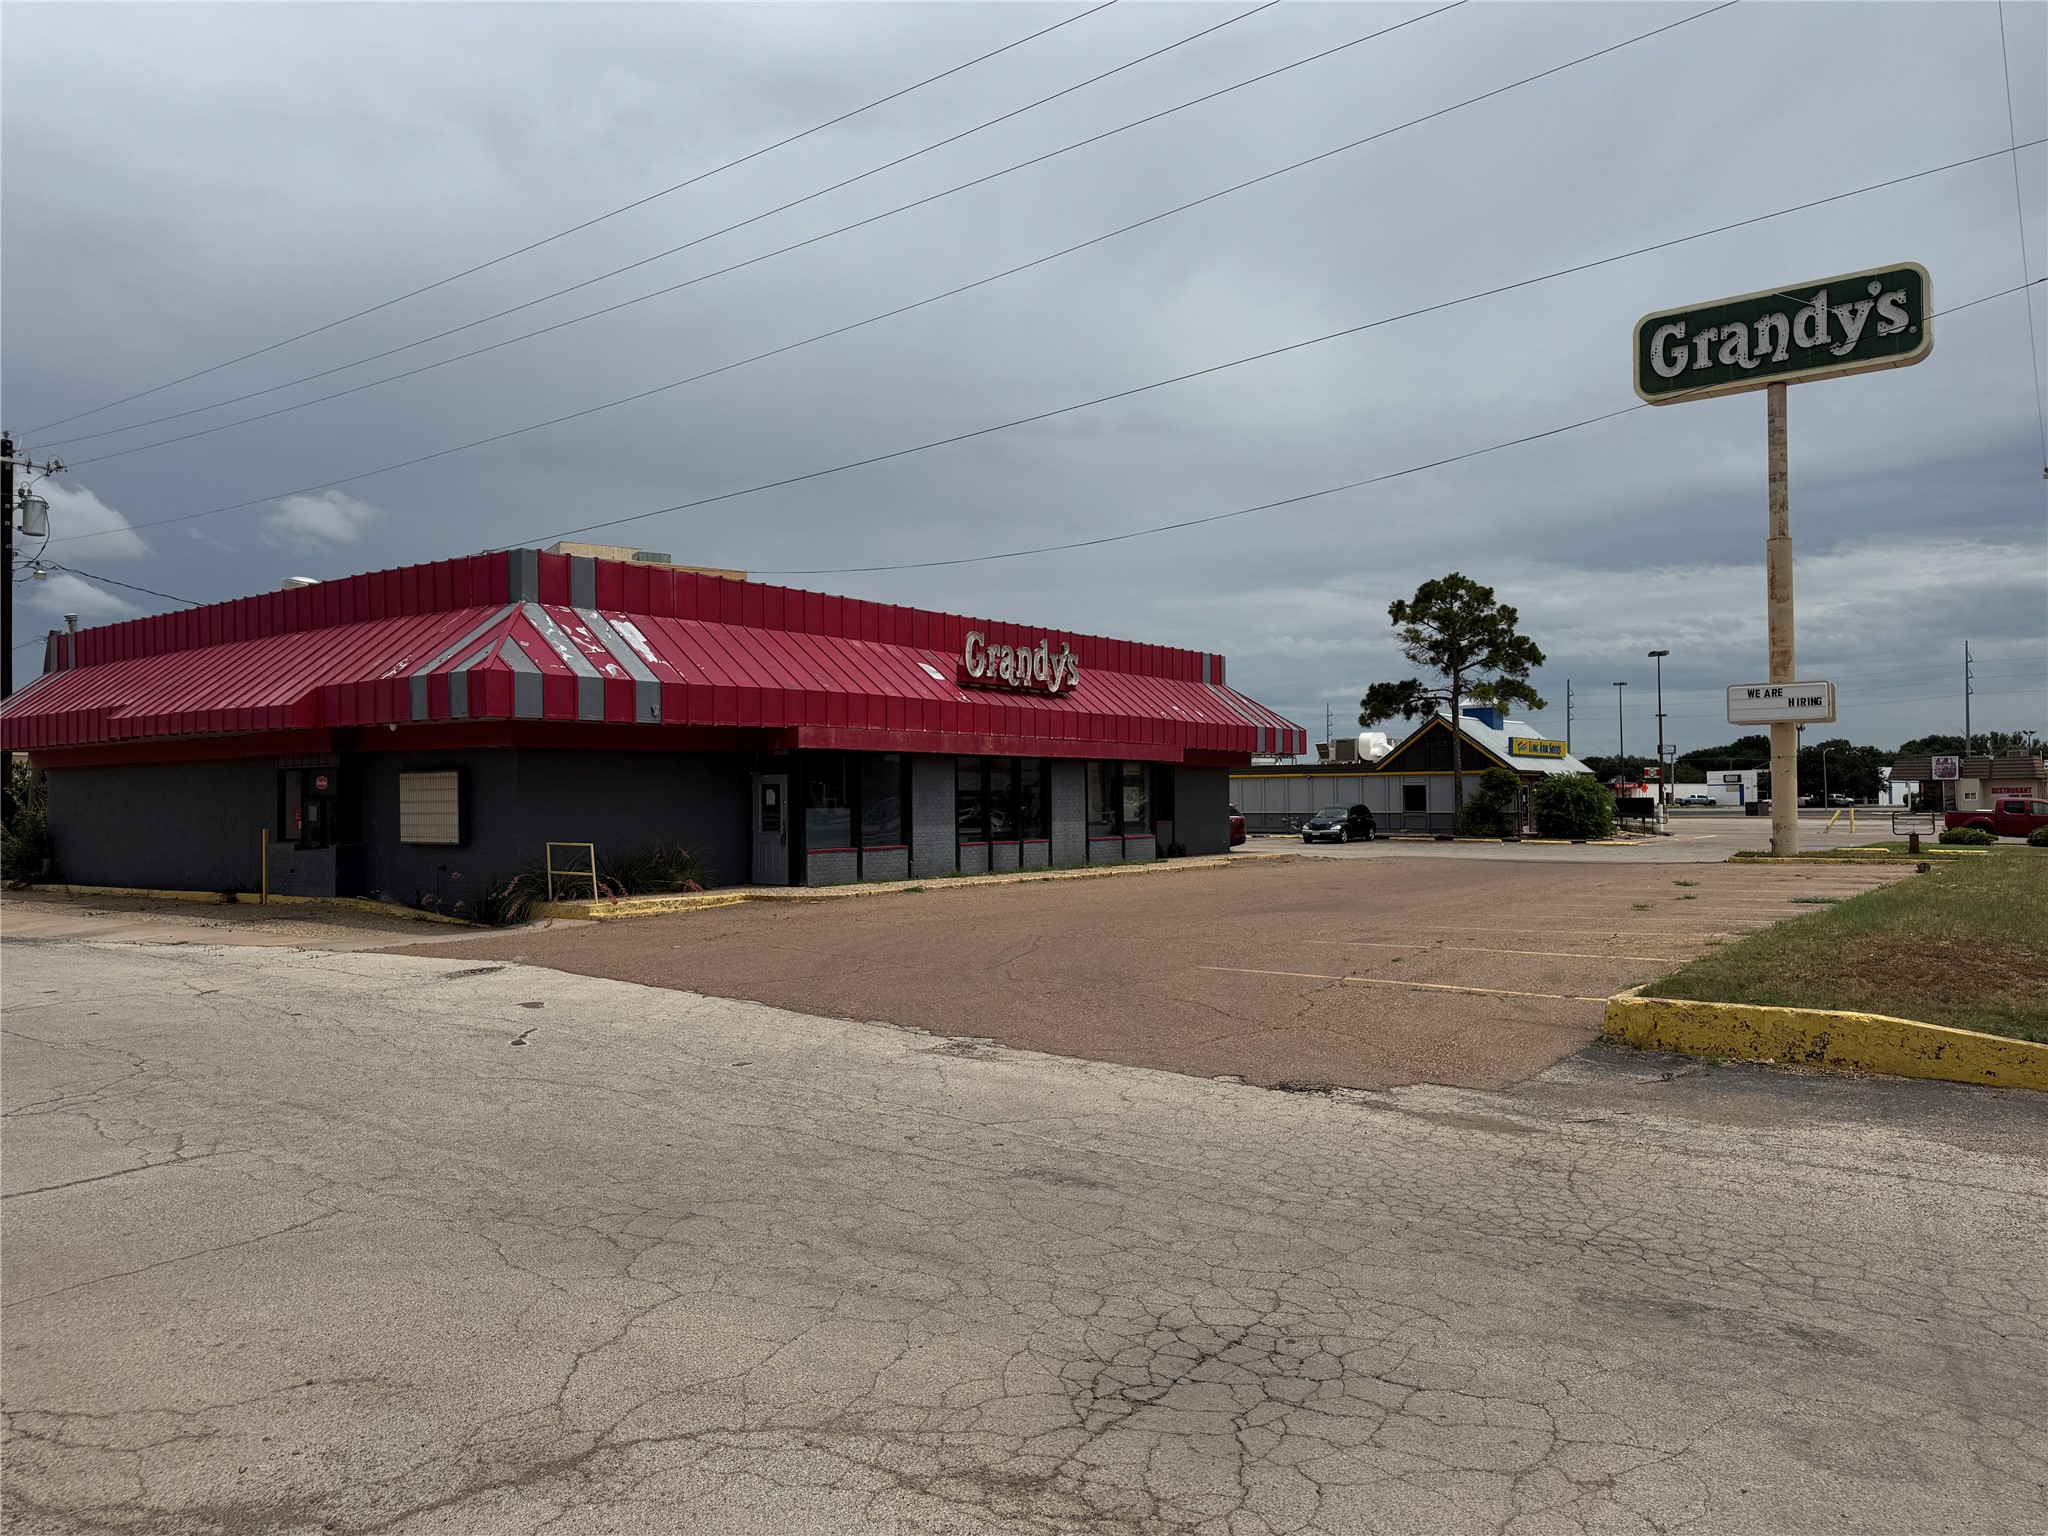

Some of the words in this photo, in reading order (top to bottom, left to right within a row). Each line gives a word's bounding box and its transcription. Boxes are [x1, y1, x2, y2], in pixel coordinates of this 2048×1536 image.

[965, 630, 1079, 693] Grandy's
[1747, 689, 1761, 698] WE
[1764, 688, 1783, 698] ARE
[1788, 696, 1822, 707] HIRING
